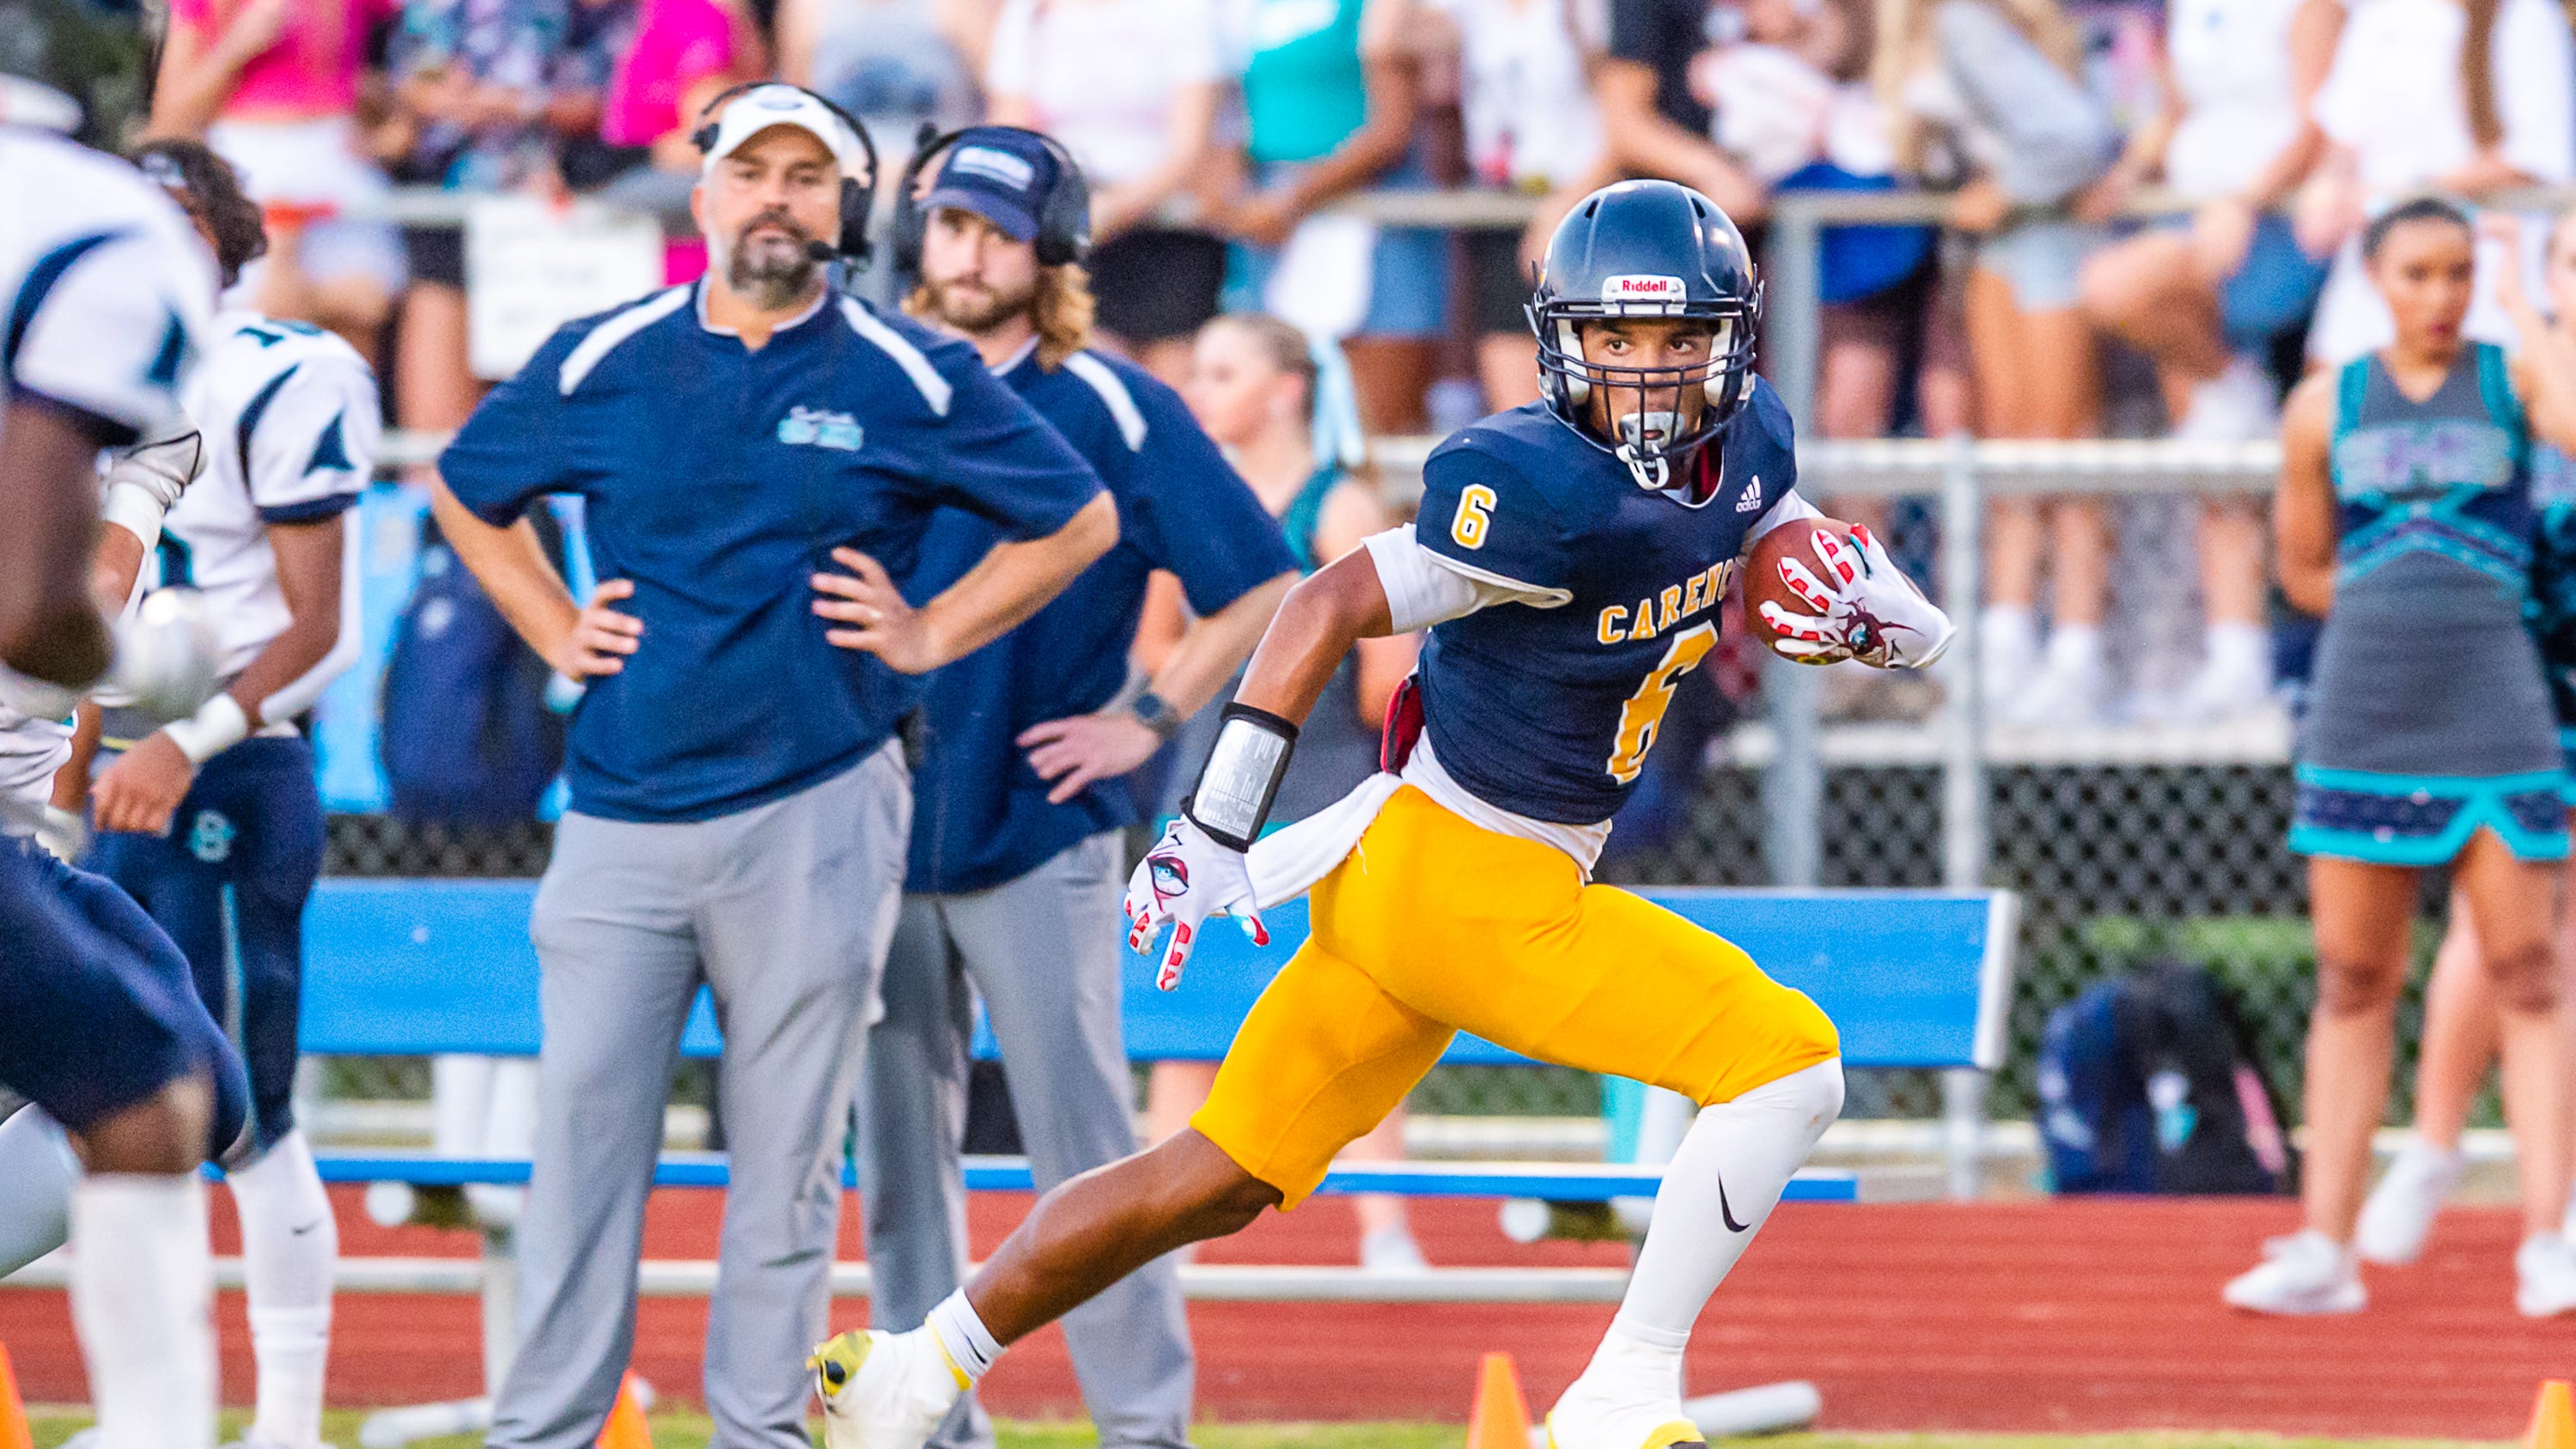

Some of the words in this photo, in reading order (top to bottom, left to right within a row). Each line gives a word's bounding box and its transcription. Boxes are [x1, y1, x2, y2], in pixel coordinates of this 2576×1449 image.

[1622, 280, 1667, 291] Riddell
[1451, 483, 1497, 550] 6
[1606, 619, 1718, 785] 6
